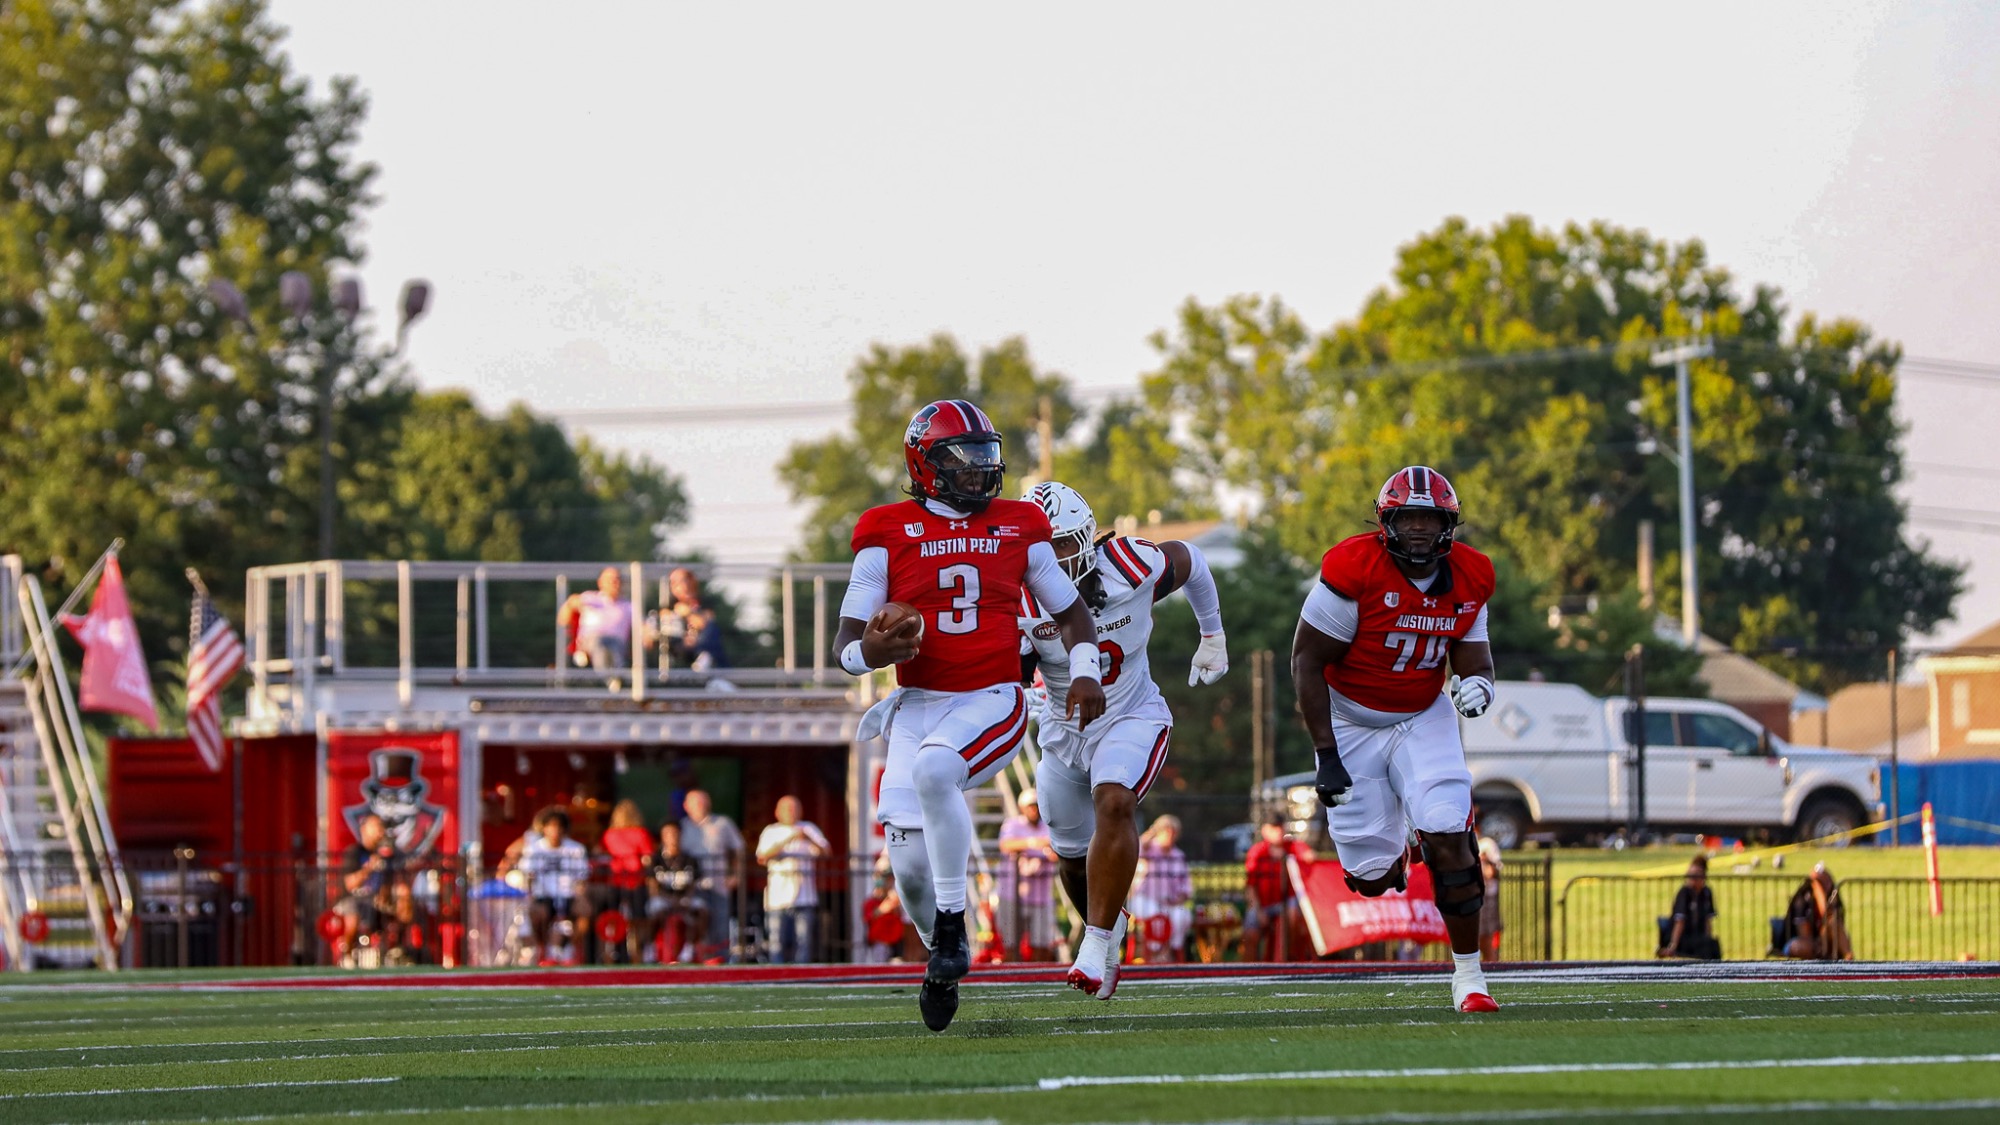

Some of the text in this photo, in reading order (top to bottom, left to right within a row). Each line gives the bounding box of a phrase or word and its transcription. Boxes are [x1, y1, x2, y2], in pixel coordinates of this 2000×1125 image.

[919, 538, 1000, 557] AUSTIN PEAY
[937, 563, 981, 634] 3
[1395, 614, 1457, 631] AUSTIN PEAY
